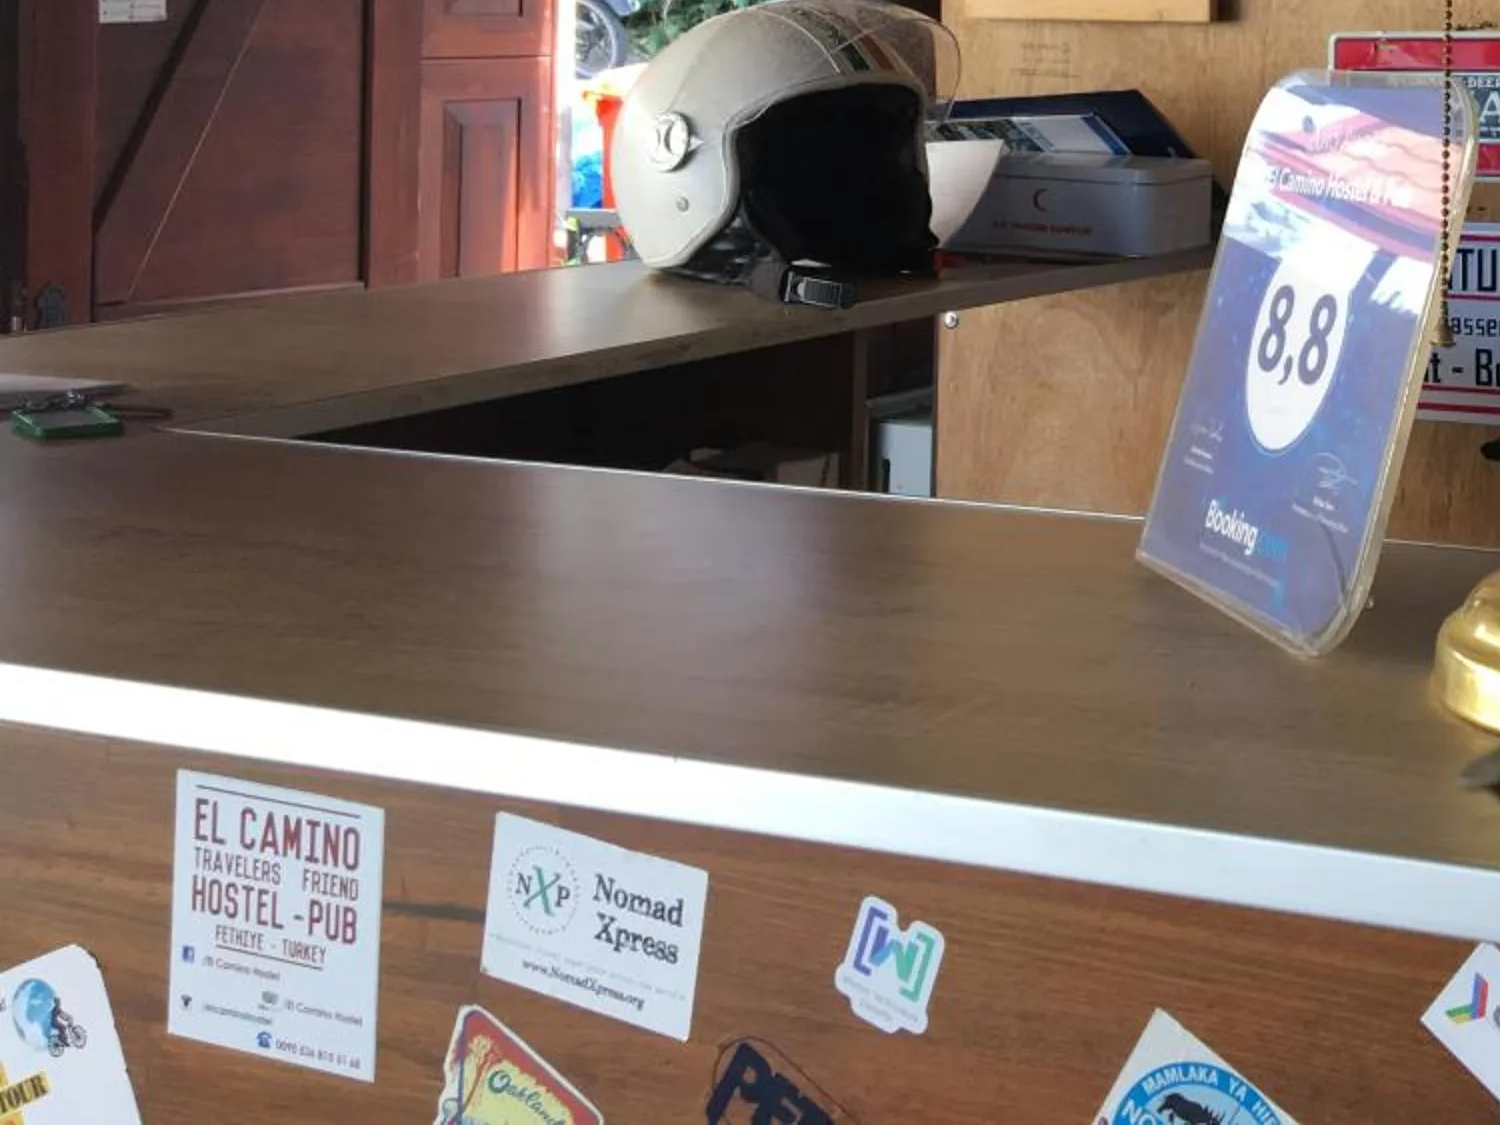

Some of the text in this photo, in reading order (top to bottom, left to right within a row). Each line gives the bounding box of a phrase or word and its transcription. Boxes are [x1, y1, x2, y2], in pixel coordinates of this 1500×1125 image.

[1257, 284, 1338, 386] 8,8
[193, 798, 361, 873] EL CAMINO
[194, 846, 359, 902] TRAVELERS FRIEND
[592, 872, 684, 928] Nomad
[192, 874, 284, 931] HOSTEL
[308, 899, 358, 946] PUB
[215, 924, 265, 951] FETHIYE
[281, 939, 327, 965] TURKEY
[593, 911, 679, 966] Xpress
